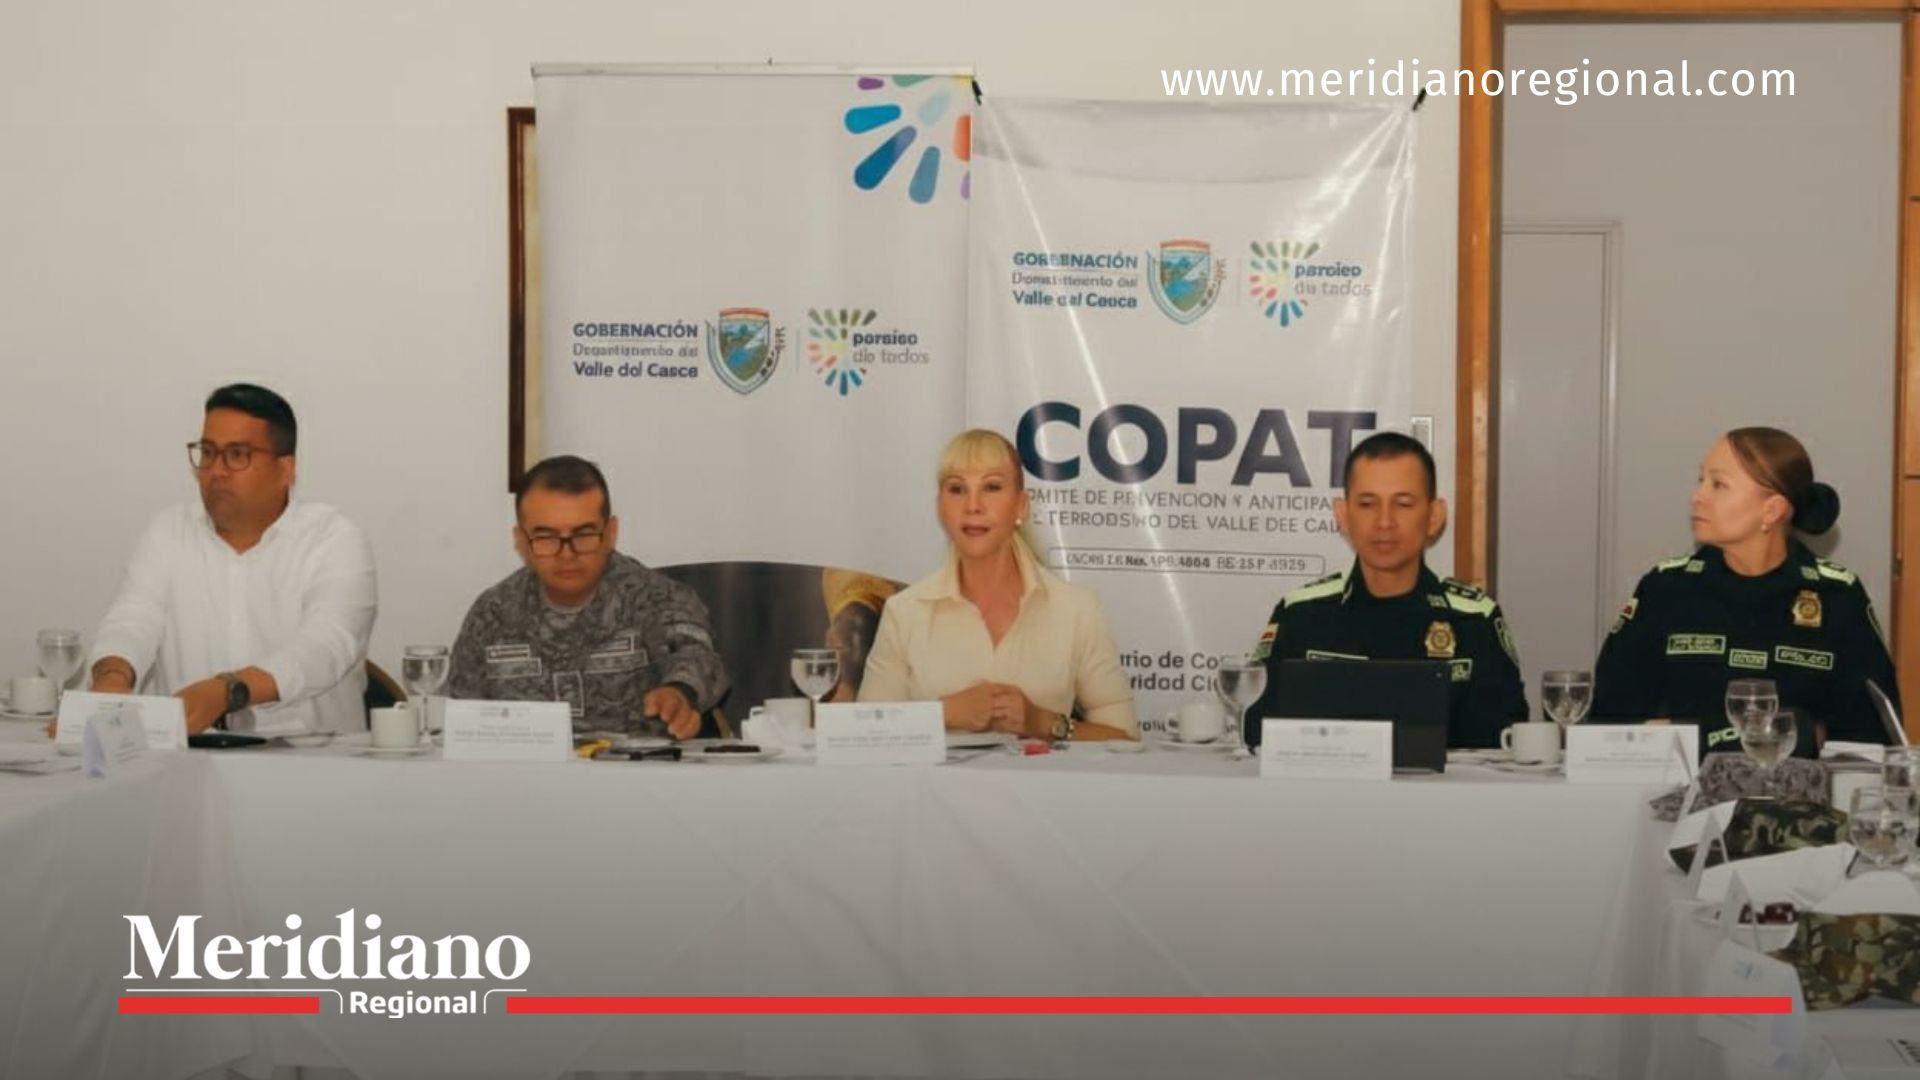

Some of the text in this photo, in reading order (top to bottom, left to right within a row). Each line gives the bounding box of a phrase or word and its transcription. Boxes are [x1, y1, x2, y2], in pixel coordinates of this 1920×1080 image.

[1013, 290, 1053, 306] Valle
[573, 320, 698, 338] GOBERNACIÓN
[574, 360, 614, 377] Valle
[1016, 401, 1376, 488] COPAT
[1085, 490, 1108, 505] DE
[1249, 494, 1331, 511] ANTICIPA
[1168, 514, 1198, 530] DEL
[1206, 515, 1260, 532] VALLE
[1158, 650, 1184, 669] de
[1191, 652, 1219, 670] Co
[1130, 673, 1184, 690] ridad
